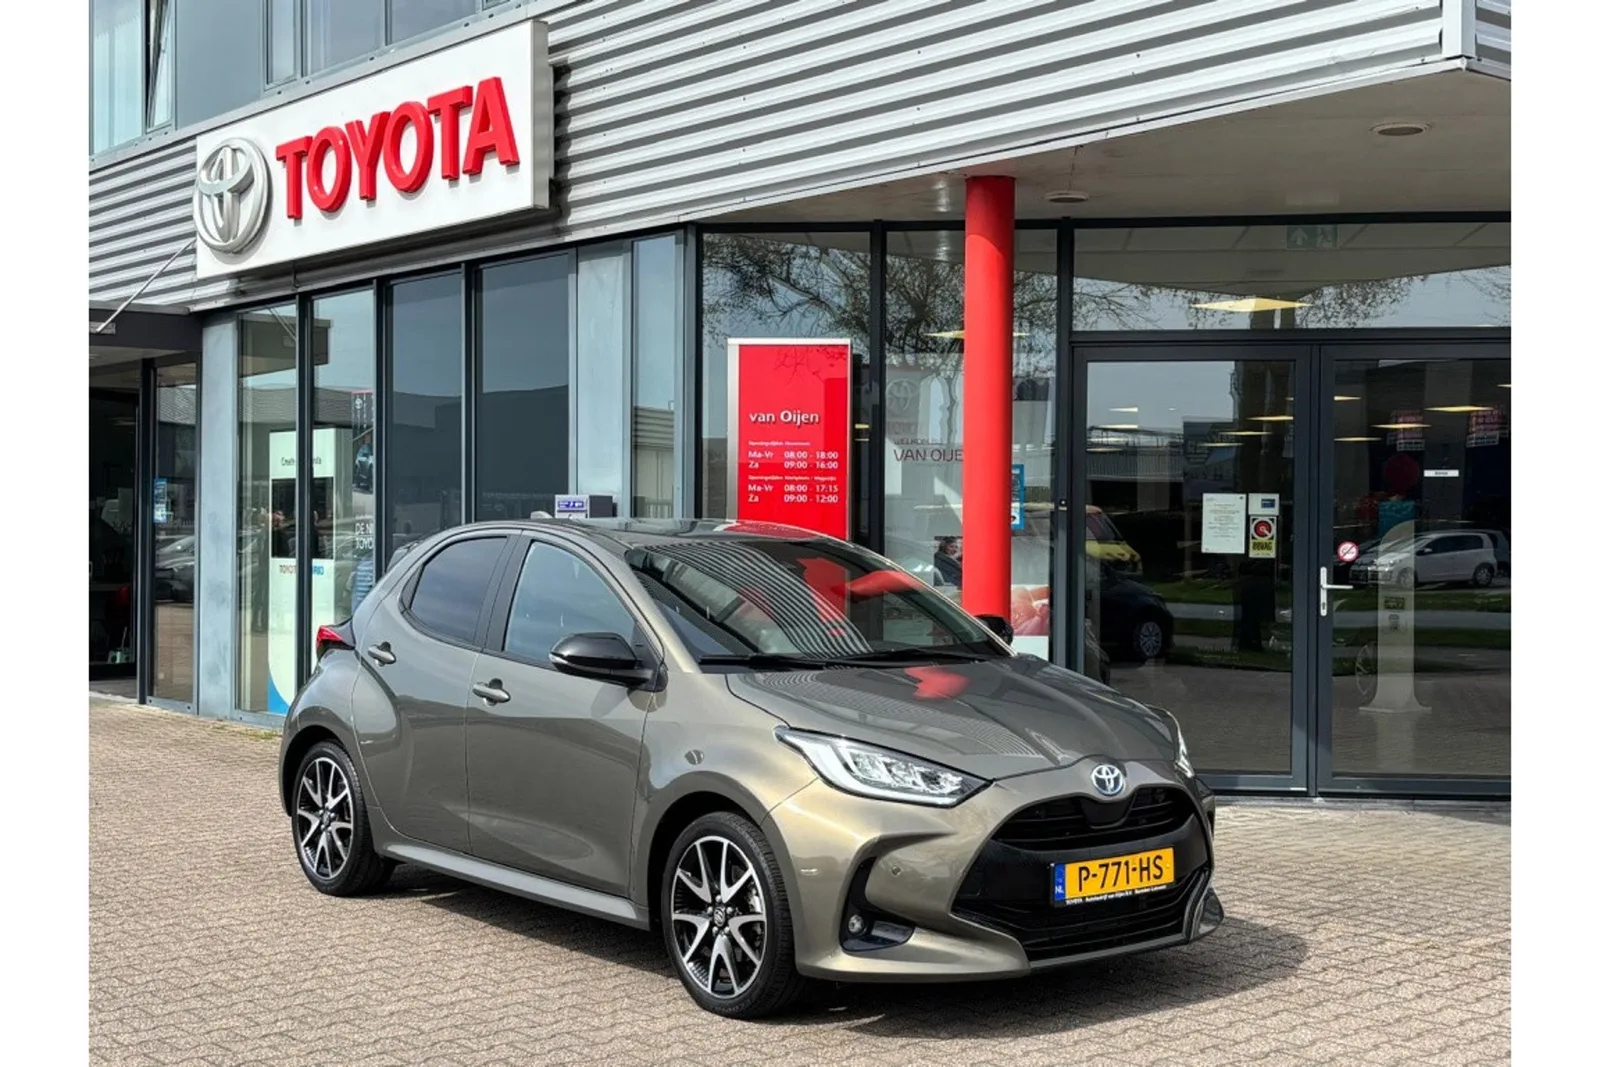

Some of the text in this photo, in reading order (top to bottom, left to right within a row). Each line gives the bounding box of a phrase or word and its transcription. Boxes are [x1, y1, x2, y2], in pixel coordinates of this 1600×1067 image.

[276, 76, 520, 220] TOYOTA
[749, 409, 820, 427] van Oijen
[747, 451, 774, 459] Ma-Vr
[783, 451, 808, 459] 08:00
[815, 451, 839, 459] 18:00
[893, 448, 926, 462] VAN
[747, 461, 759, 469] Za
[783, 461, 808, 469] 09:00
[815, 461, 839, 469] 16:00
[747, 484, 774, 492] Ma-Vr
[783, 484, 808, 492] 08:00
[815, 484, 839, 492] 17:15
[747, 494, 759, 502] Za
[783, 494, 808, 502] 09:00
[815, 495, 839, 503] 12:00
[1078, 855, 1164, 892] P-771-HS
[1055, 885, 1065, 895] NL
